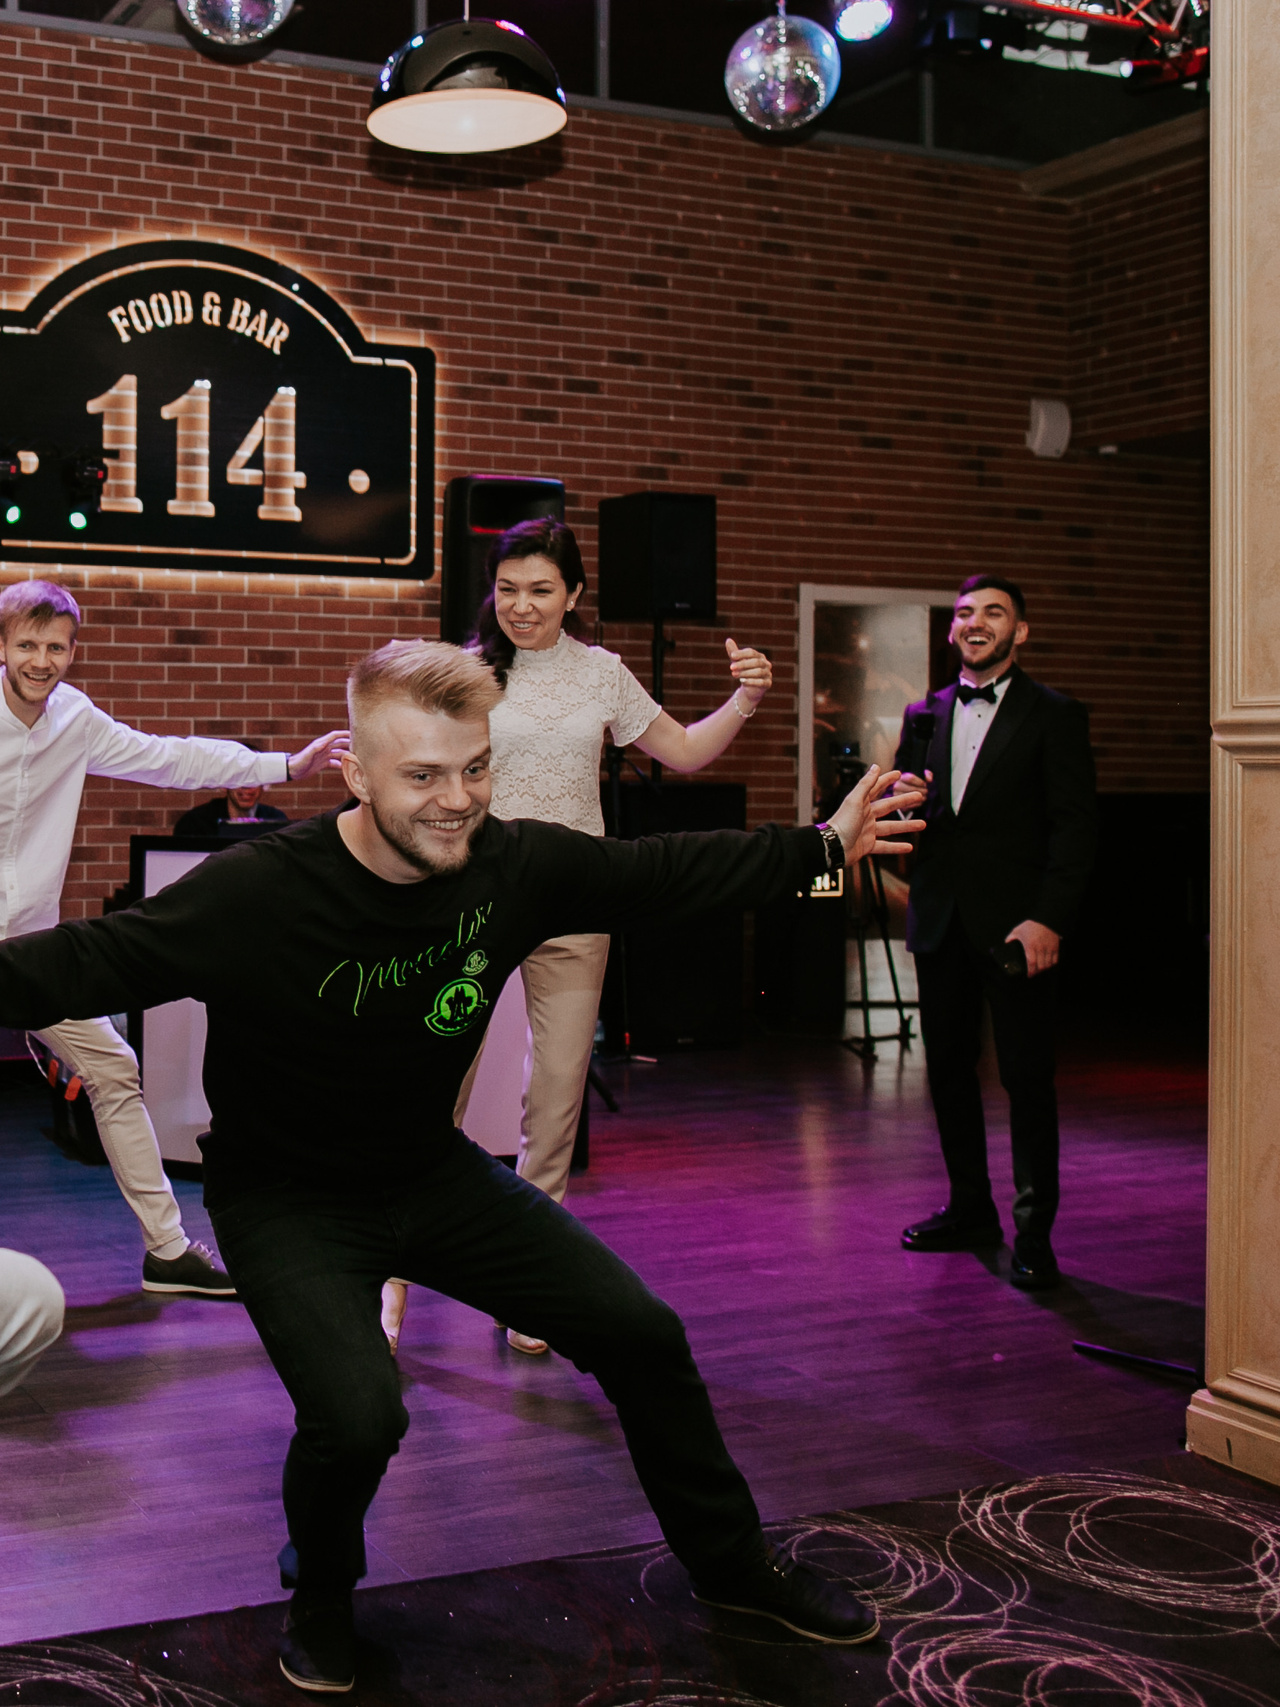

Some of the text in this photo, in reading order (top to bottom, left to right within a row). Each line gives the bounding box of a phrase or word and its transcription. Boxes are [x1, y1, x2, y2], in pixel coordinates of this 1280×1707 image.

[107, 290, 291, 356] FOOD & BAR
[86, 373, 307, 523] 114
